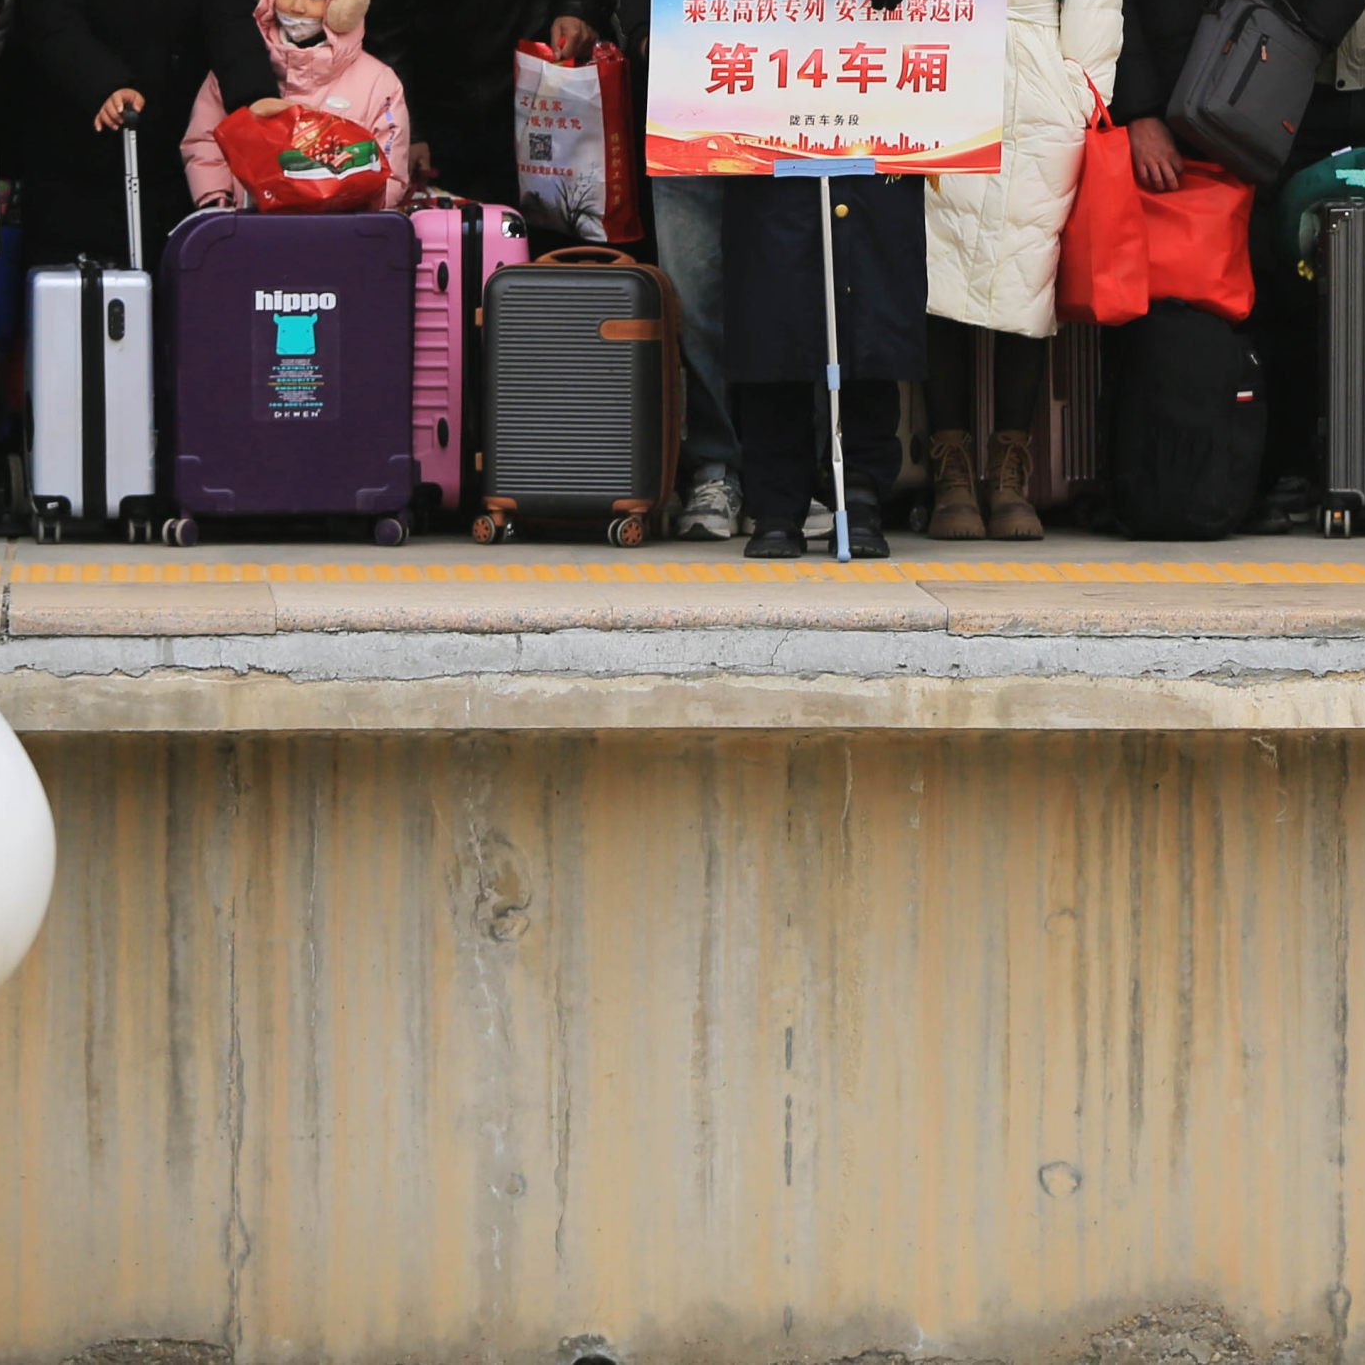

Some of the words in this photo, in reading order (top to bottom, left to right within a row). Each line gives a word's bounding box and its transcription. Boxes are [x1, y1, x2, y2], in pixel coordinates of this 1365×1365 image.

[705, 42, 950, 95] 第14车厢
[789, 114, 860, 127] 陇西车务段
[255, 290, 337, 312] hippo
